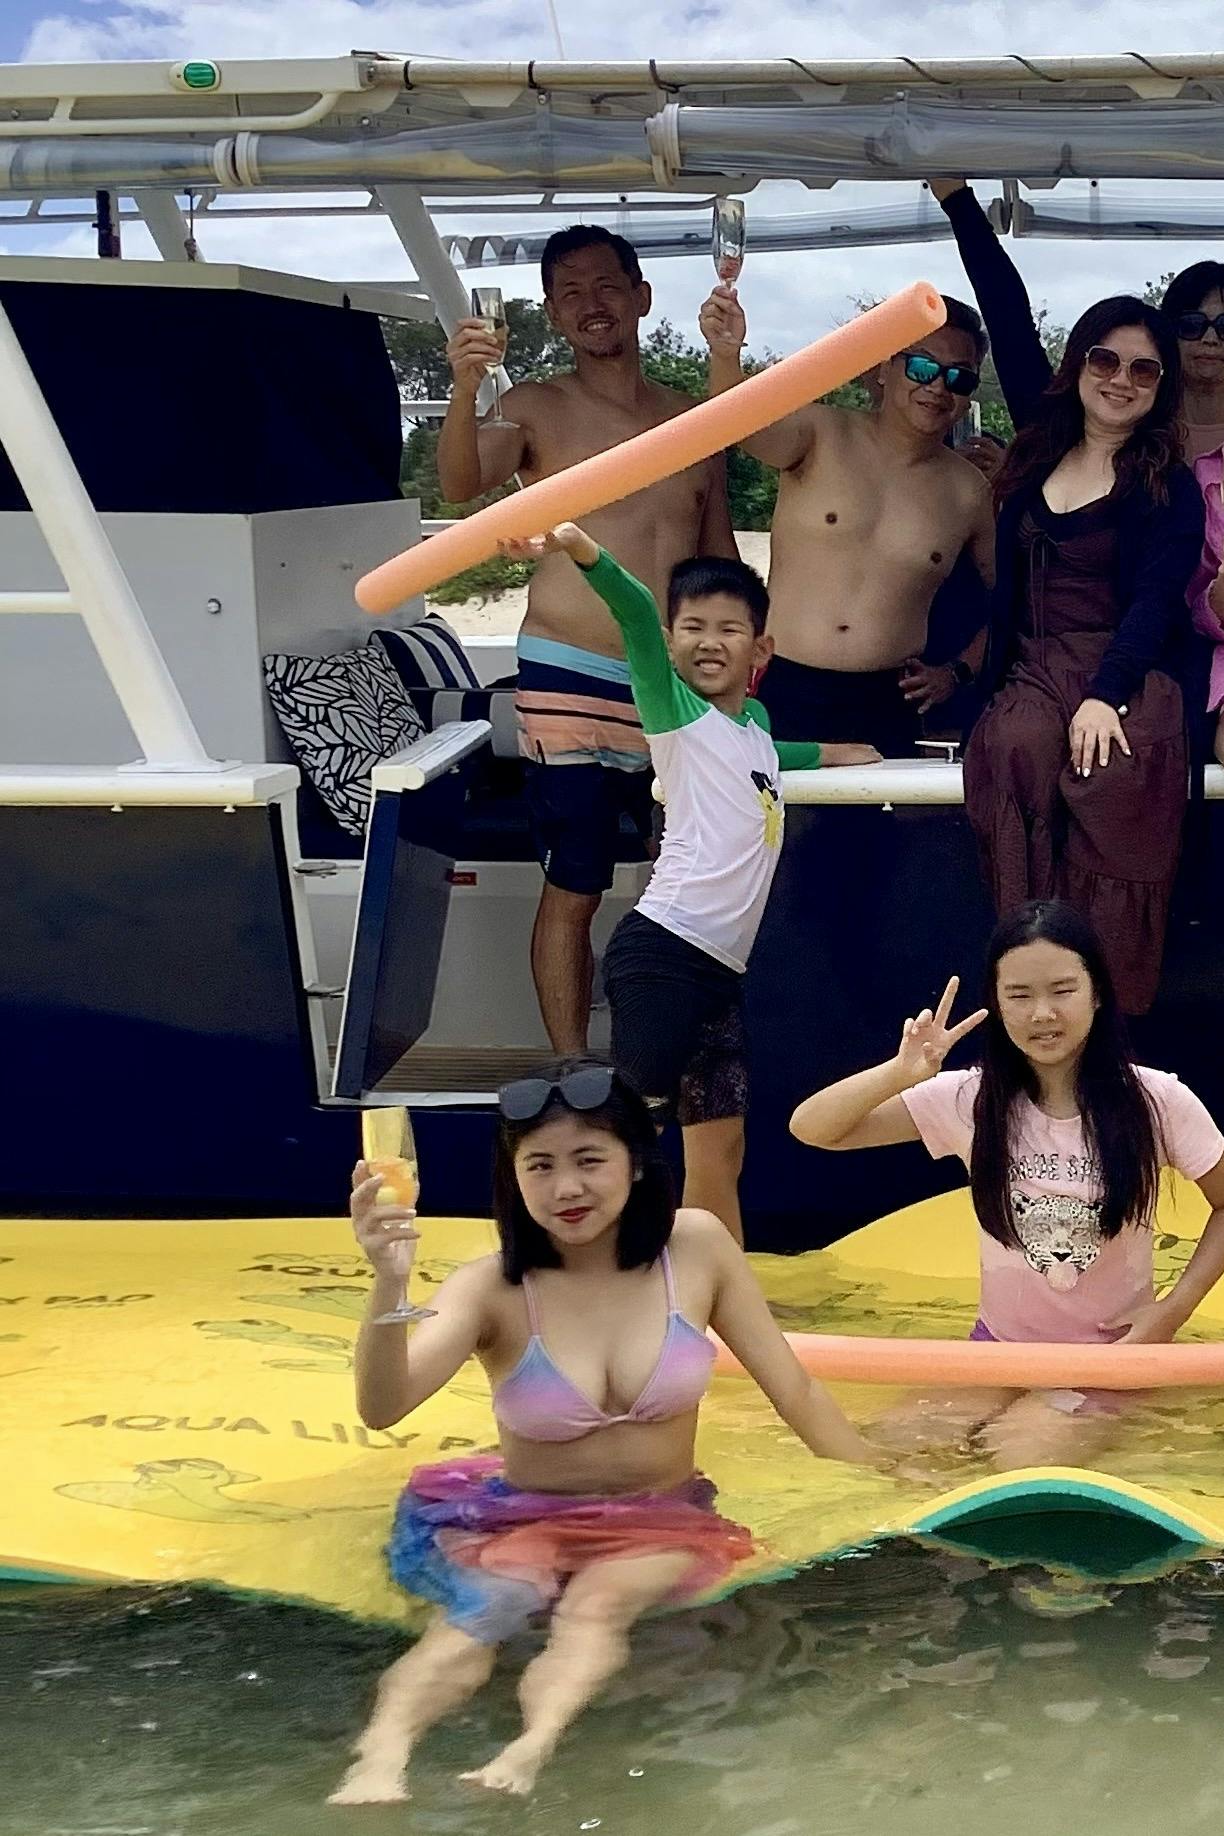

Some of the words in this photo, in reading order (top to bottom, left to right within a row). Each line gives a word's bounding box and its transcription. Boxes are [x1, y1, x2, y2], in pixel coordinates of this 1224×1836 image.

[239, 1264, 375, 1278] AQU
[61, 1414, 270, 1434] AQUA
[292, 1420, 420, 1449] LILY
